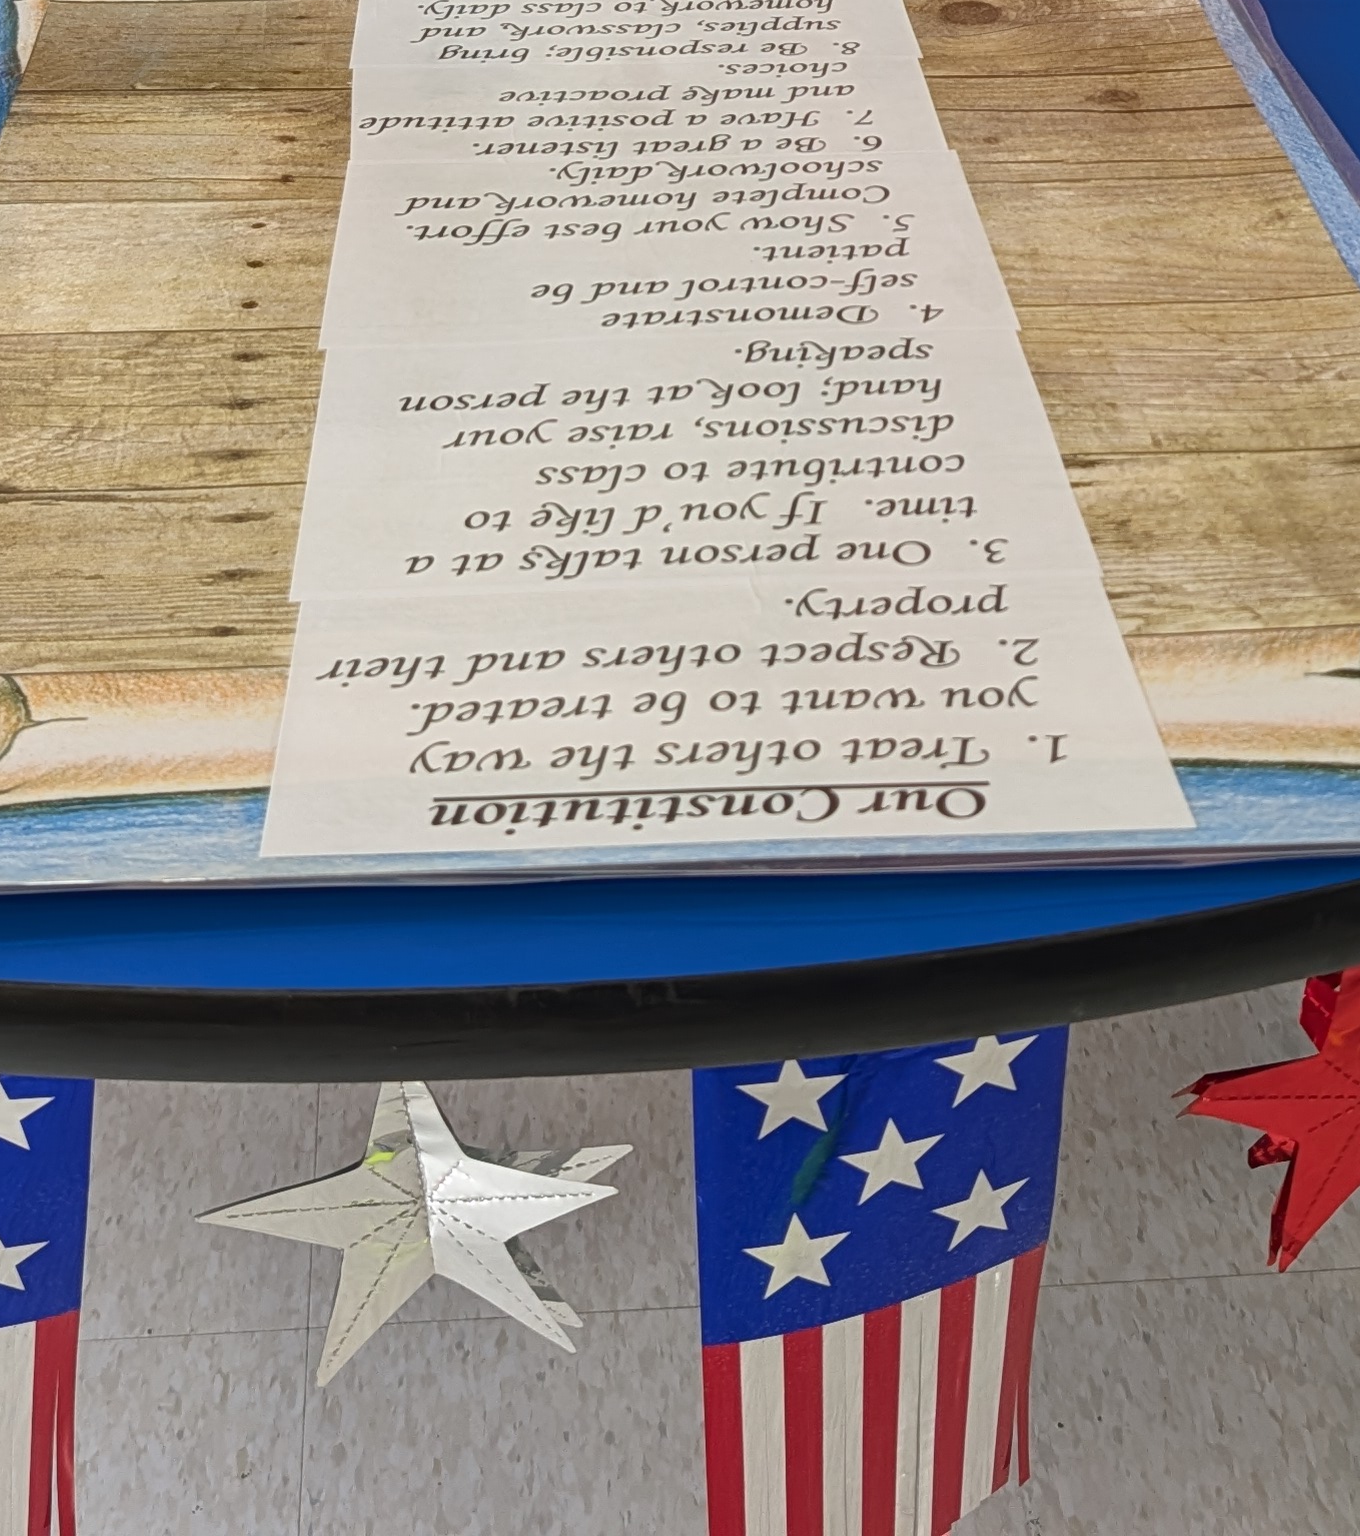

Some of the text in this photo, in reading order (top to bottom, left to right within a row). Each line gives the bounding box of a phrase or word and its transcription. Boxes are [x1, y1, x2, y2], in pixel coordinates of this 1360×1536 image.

[472, 133, 883, 161] 6. Be a great listener.
[753, 237, 910, 262] patient.
[530, 267, 918, 306] self-control and be
[601, 304, 944, 330] 4. Demonstrate
[405, 533, 1008, 581] 3. One person talks at a
[784, 583, 1008, 621] property.
[315, 632, 1039, 689] 2. Respect others and their
[406, 675, 1038, 737] you want to be treated.
[409, 734, 1067, 781] 1. Treat others the way
[427, 783, 988, 837] Our Constitution
